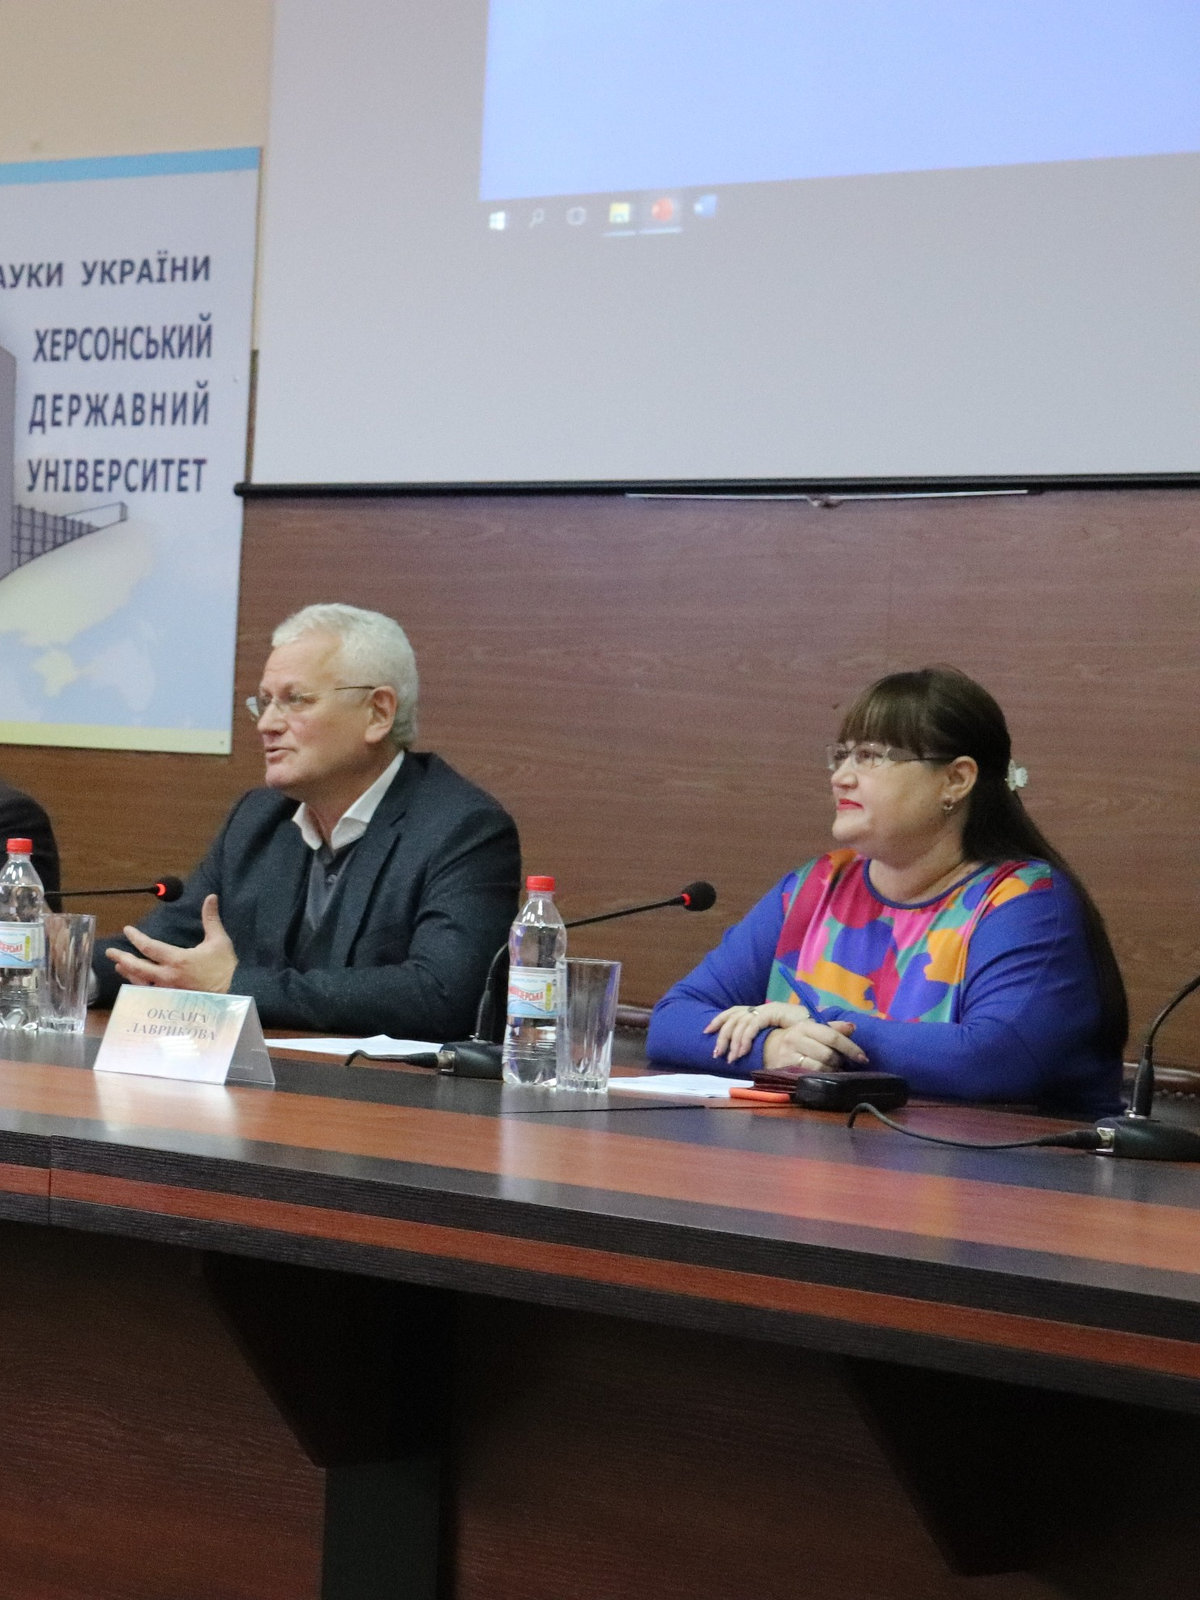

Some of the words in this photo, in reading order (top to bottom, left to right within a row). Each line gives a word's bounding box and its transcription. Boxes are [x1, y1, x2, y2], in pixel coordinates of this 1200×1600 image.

[81, 252, 212, 285] УКРАЇНИ
[34, 313, 213, 362] ХЕРСОНСЬКИЙ
[28, 380, 210, 434] ДЕРЖАВНИЙ
[27, 458, 207, 493] УНІВЕРСИТЕТ
[126, 1022, 218, 1042] ЛАВРИКОВА
[146, 1008, 209, 1024] ОКСАНА
